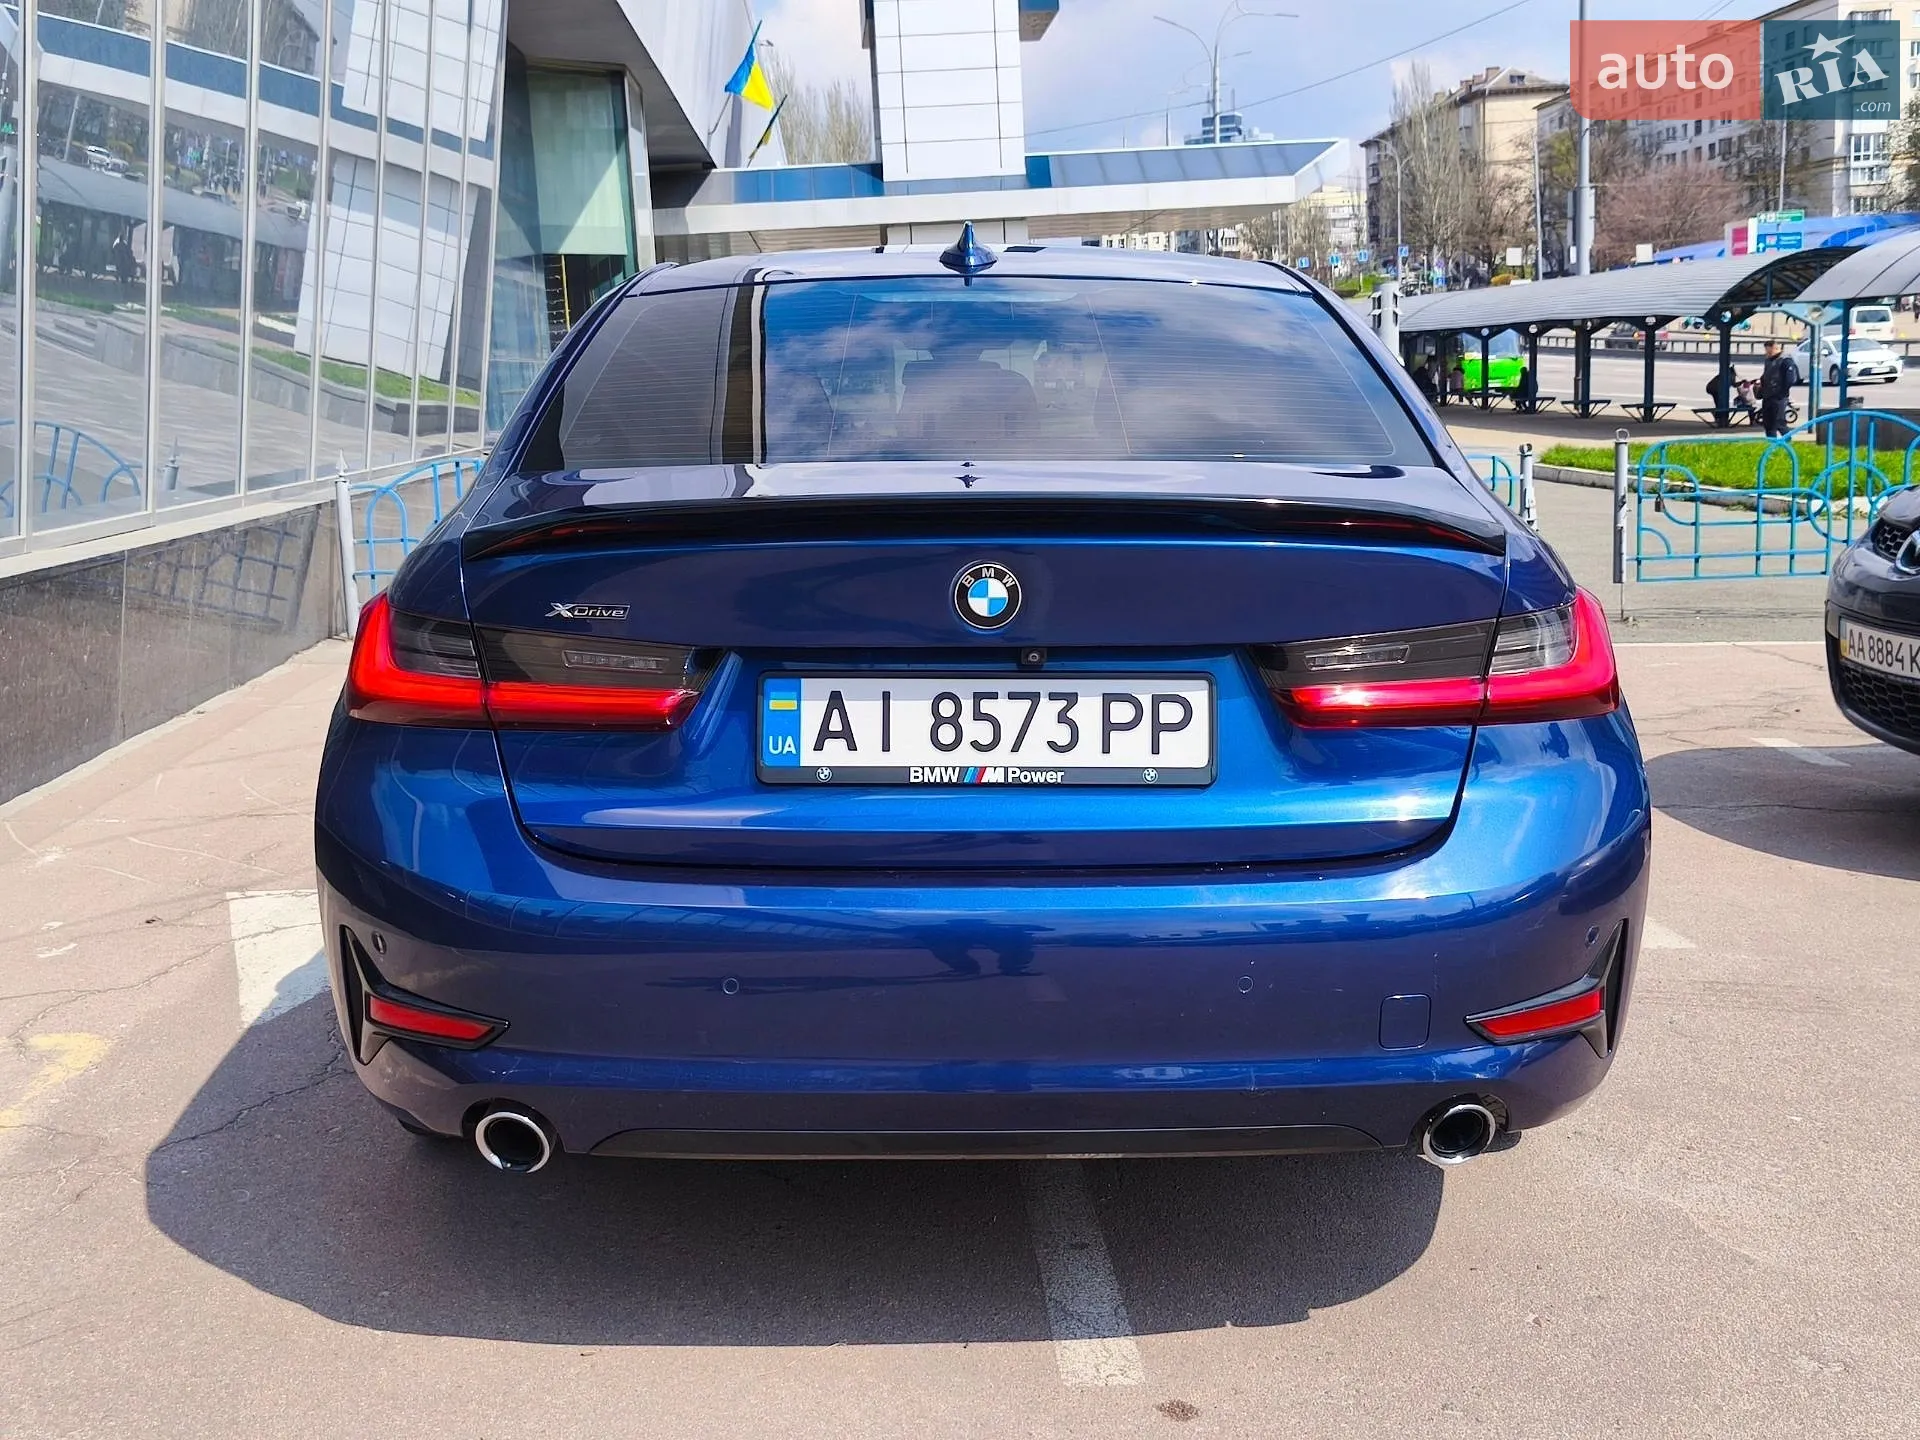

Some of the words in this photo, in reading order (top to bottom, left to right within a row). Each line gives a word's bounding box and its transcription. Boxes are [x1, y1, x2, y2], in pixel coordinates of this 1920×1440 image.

[961, 567, 1016, 588] BMW
[1847, 628, 1866, 661] AA
[1867, 634, 1905, 672] 8884
[813, 690, 891, 752] AI
[930, 691, 1080, 753] 8573
[1101, 692, 1194, 755] PP
[768, 735, 798, 755] UA
[909, 766, 960, 783] BMW
[1007, 766, 1065, 783] Power
